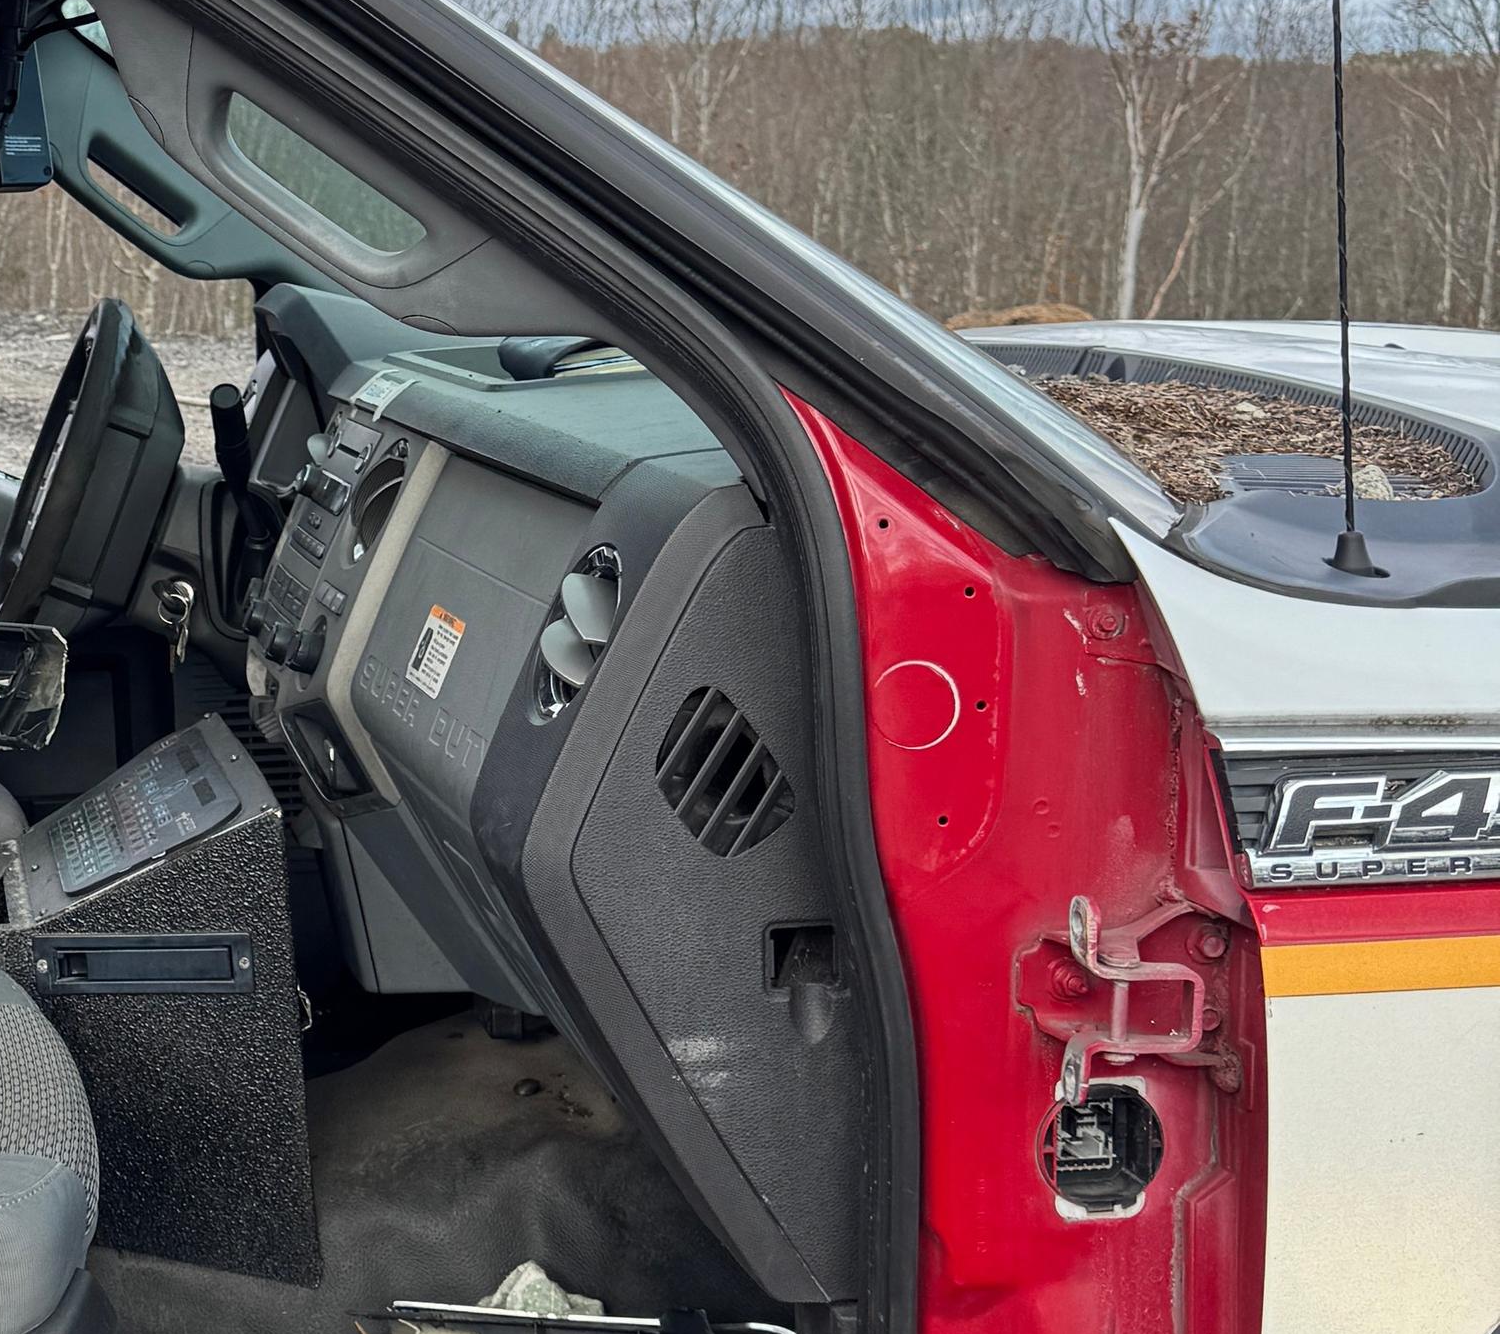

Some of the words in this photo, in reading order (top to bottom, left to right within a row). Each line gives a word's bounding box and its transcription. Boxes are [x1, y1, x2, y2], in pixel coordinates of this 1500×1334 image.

[359, 655, 421, 727] SUPER
[1271, 773, 1500, 849] F-4
[1270, 857, 1473, 883] SUPER
